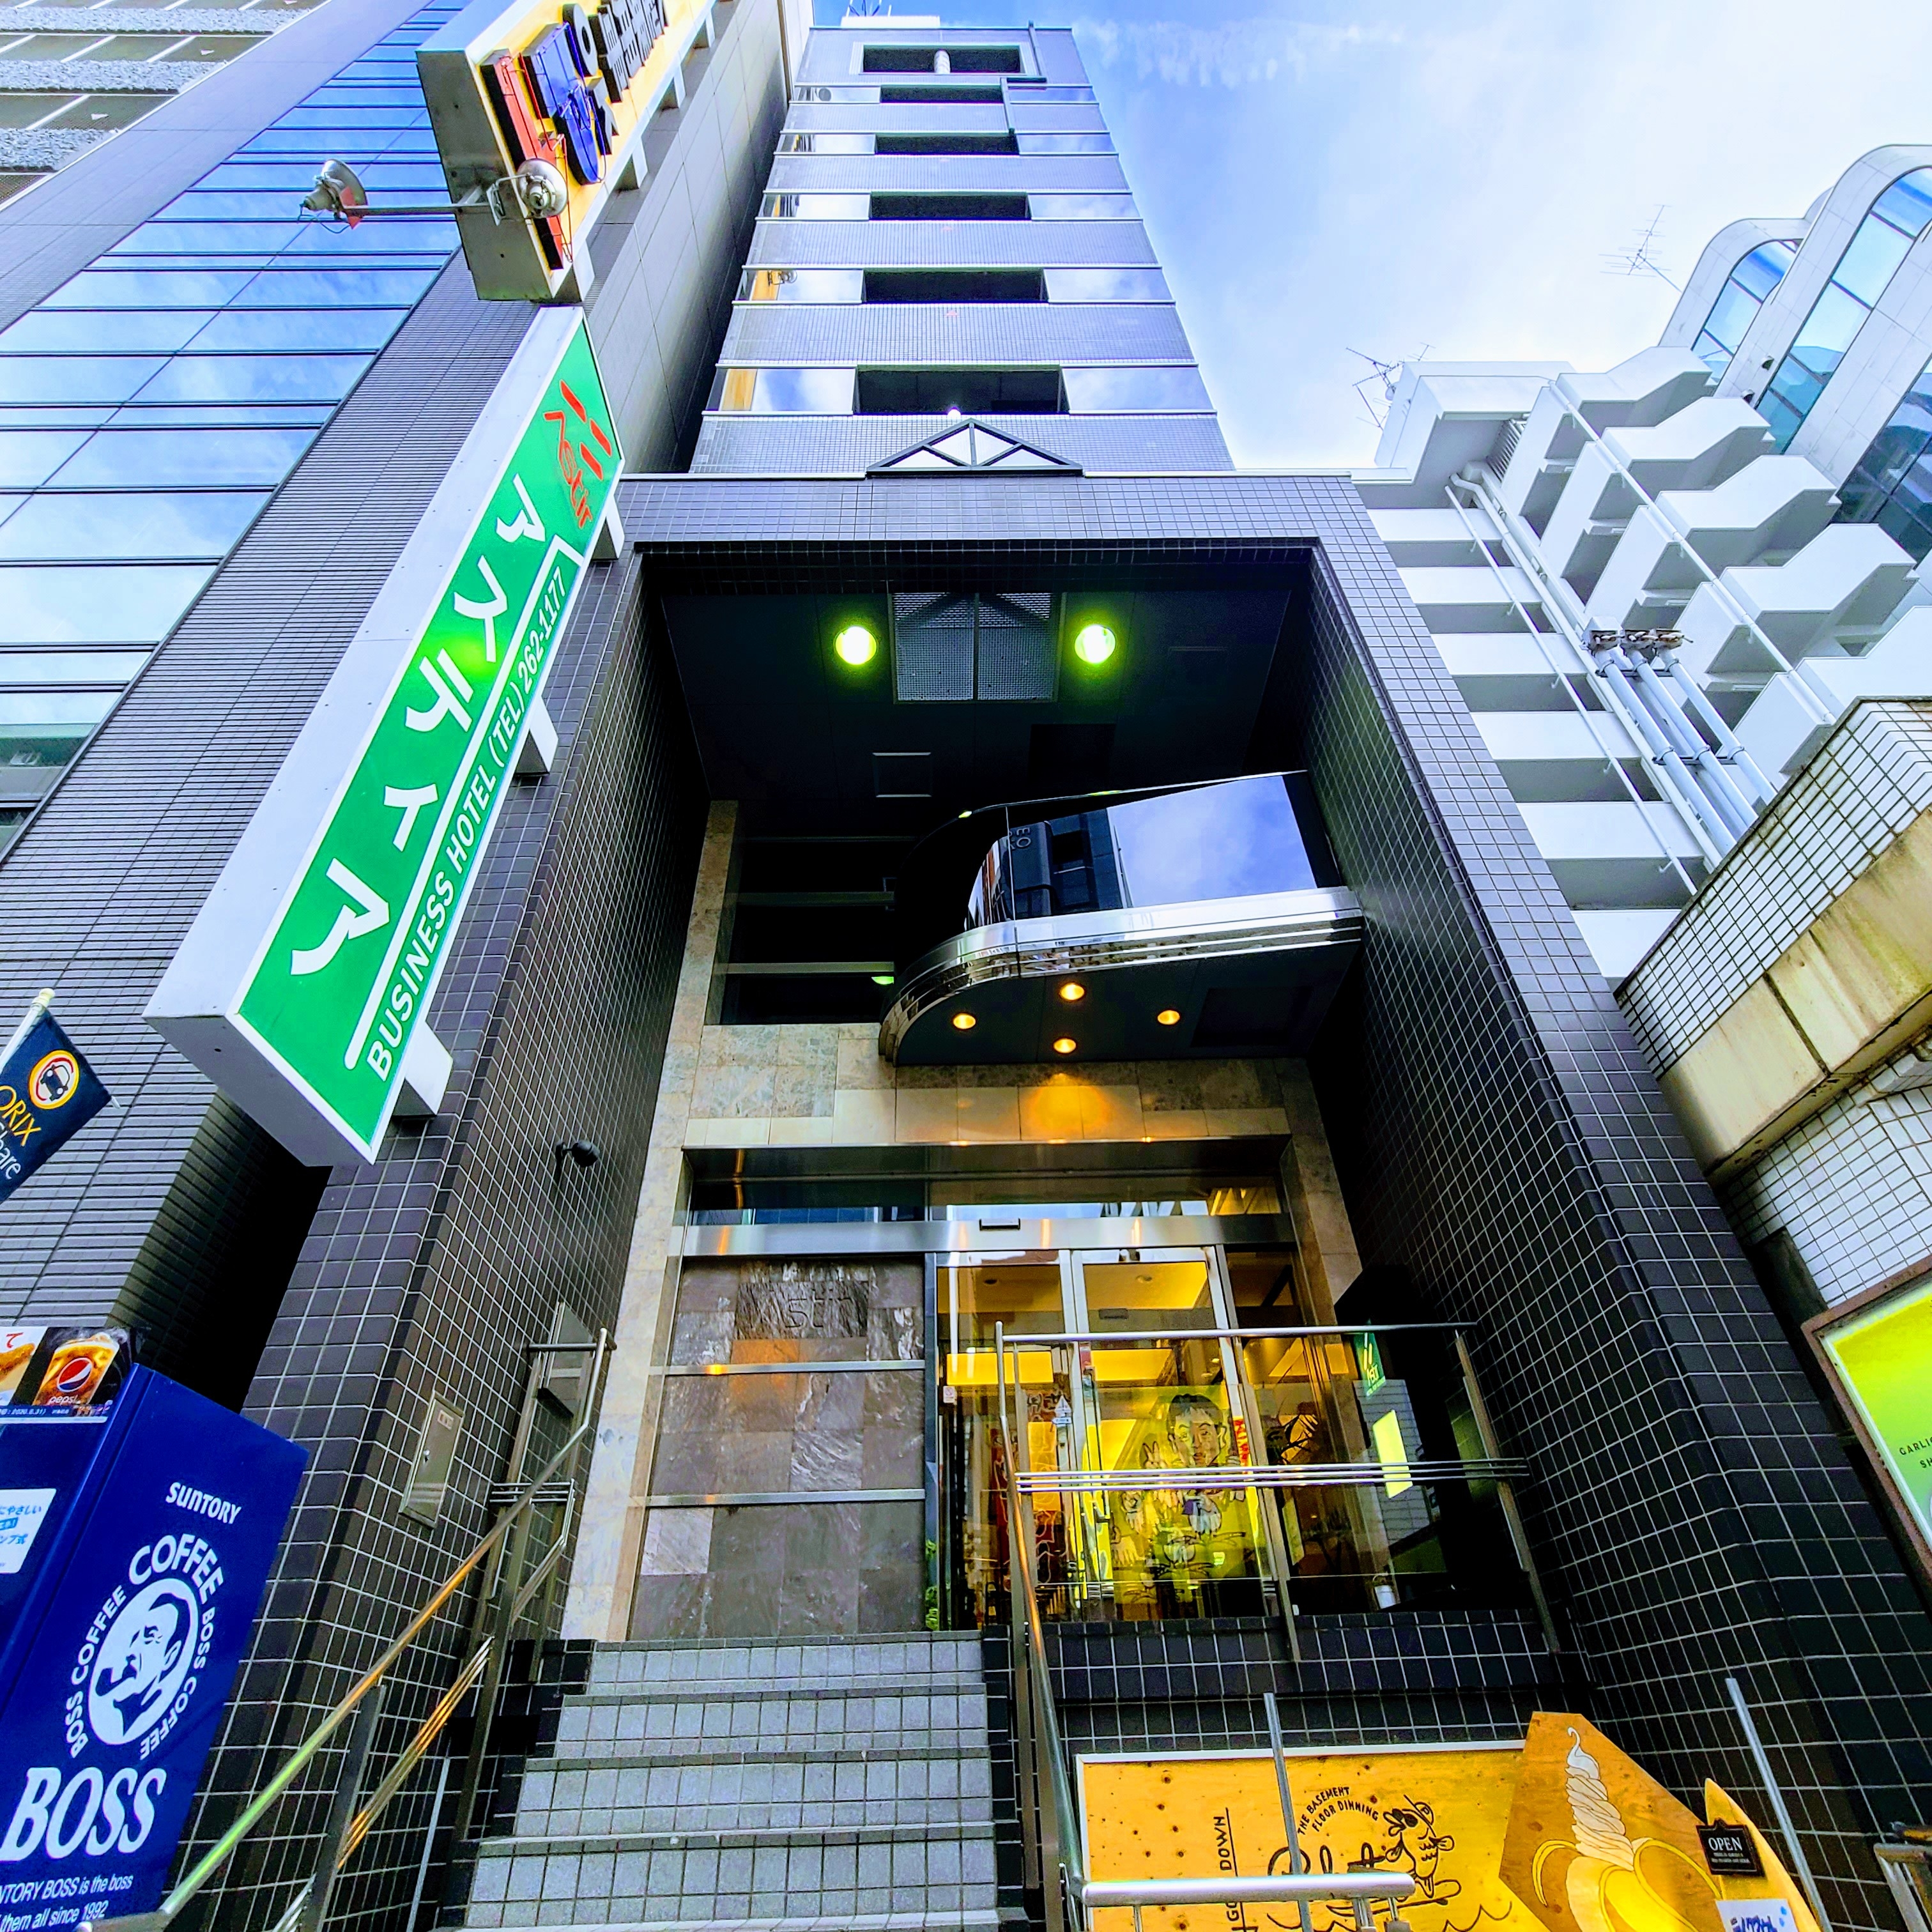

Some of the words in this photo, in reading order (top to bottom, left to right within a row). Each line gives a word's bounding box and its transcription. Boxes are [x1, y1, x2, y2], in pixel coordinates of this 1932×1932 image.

[290, 473, 546, 976] アスティア
[366, 870, 454, 1082] BUSINESS
[446, 764, 496, 874] HOTEL
[488, 681, 525, 767] (TEL)
[518, 566, 565, 695] 262-1177
[0, 1085, 42, 1147] ORIX
[165, 1482, 242, 1525] SUNTORY
[128, 1533, 224, 1605] COFFEE
[71, 1584, 127, 1685] COFFEE
[193, 1606, 215, 1669] BOSS
[65, 1690, 89, 1759] BOSS
[139, 1676, 197, 1761] COFFEE
[0, 1767, 167, 1862] BOSS
[1297, 1814, 1310, 1836] THE
[1306, 1786, 1350, 1814] BASEMENT
[1312, 1804, 1336, 1832] FLOOR
[1213, 1816, 1232, 1871] DOWN
[1708, 1837, 1743, 1851] OPEN
[0, 1913, 32, 1932] them
[31, 1907, 51, 1930] all
[49, 1906, 80, 1928] since
[81, 1899, 109, 1920] 1992
[42, 1876, 80, 1900] BOSS
[79, 1876, 89, 1896] is
[90, 1874, 109, 1894] the
[108, 1873, 134, 1892] boss
